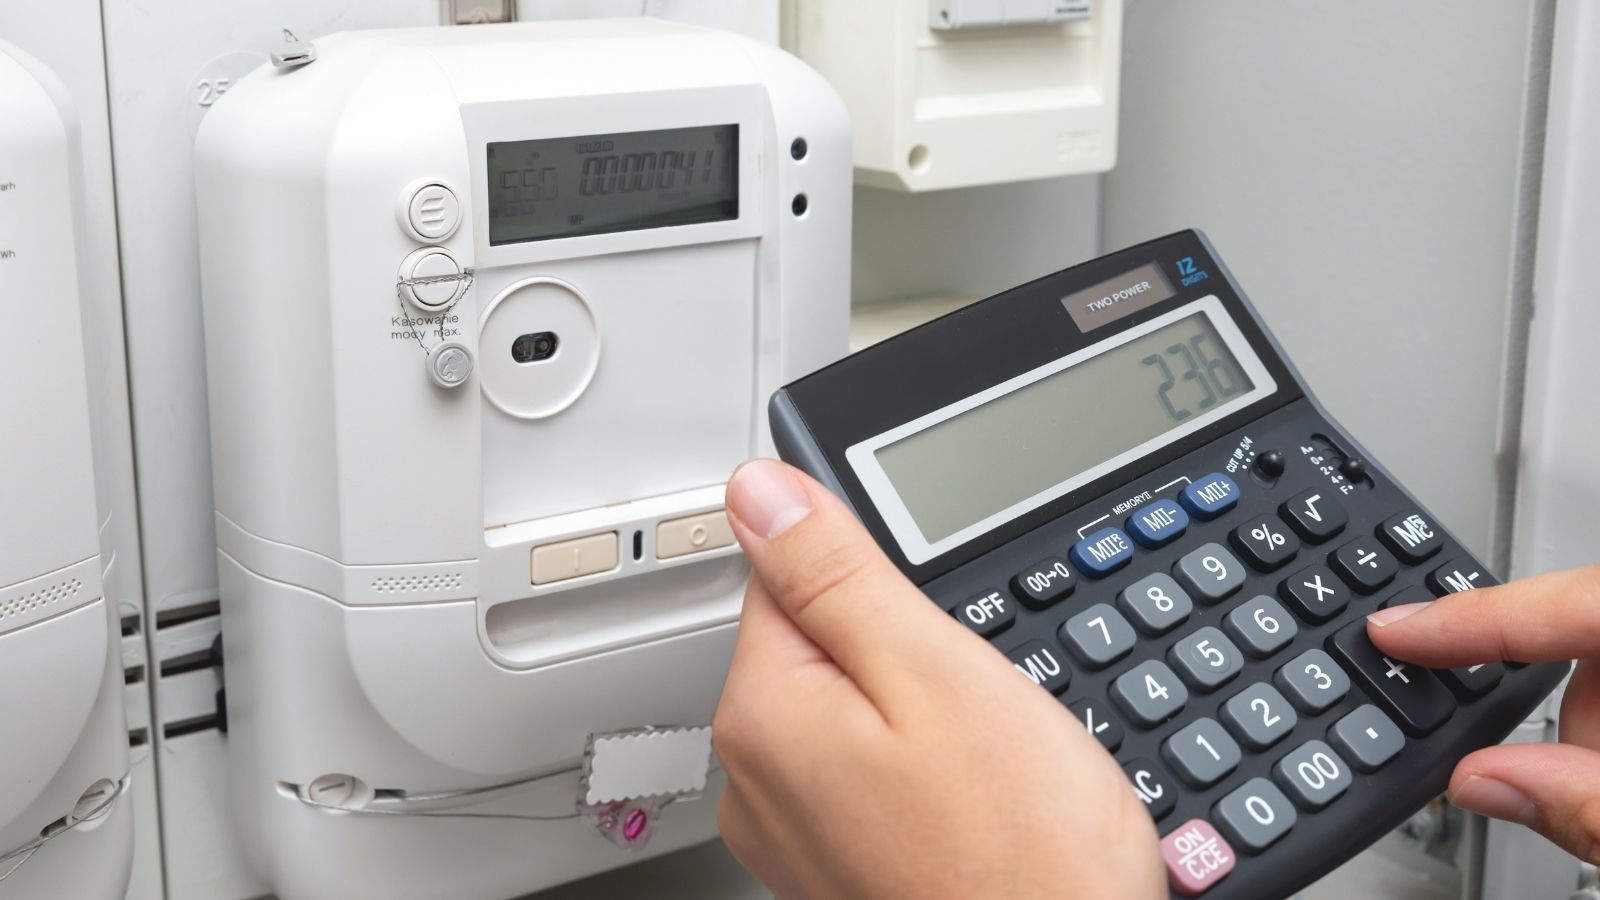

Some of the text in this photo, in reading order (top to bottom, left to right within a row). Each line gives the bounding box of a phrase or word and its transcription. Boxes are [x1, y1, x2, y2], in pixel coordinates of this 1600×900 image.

[1176, 256, 1198, 276] 12
[1087, 281, 1151, 312] TWO POWER
[1141, 333, 1242, 421] 236
[1226, 435, 1254, 473] CUT UP 5/4
[1250, 523, 1286, 551] %
[1202, 556, 1228, 581] 9
[965, 592, 1005, 625] OFF
[1146, 586, 1174, 612] 8
[1087, 616, 1112, 645] 7
[1253, 608, 1280, 634] 6
[1195, 639, 1225, 667] 5
[1144, 673, 1169, 700] 4
[1304, 663, 1332, 690] 3
[1250, 698, 1281, 728] 2
[1196, 734, 1222, 761] 1
[1297, 752, 1340, 790] 00
[1245, 796, 1275, 826] 0
[1173, 826, 1205, 853] ON
